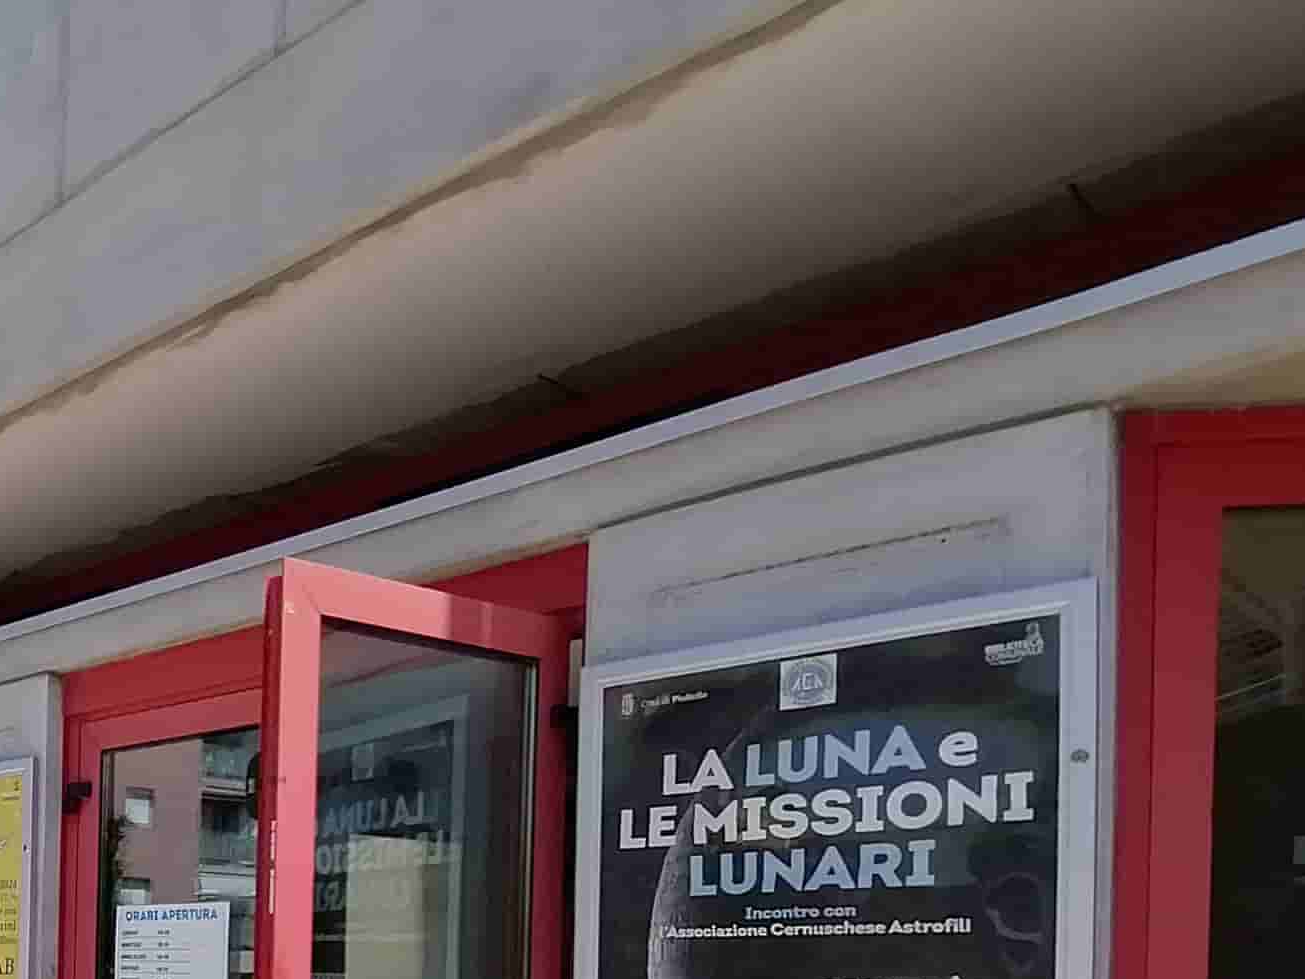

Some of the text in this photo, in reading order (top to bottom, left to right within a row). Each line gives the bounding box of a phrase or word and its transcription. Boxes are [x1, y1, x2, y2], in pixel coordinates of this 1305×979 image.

[662, 725, 978, 796] LA LUNA e
[619, 771, 1035, 850] LE MISSIONI
[689, 839, 937, 897] LUNARI
[162, 907, 218, 921] APERTURA
[744, 904, 857, 920] Incontro con
[770, 920, 886, 938] Cernuschese
[888, 917, 972, 936] Astrofili
